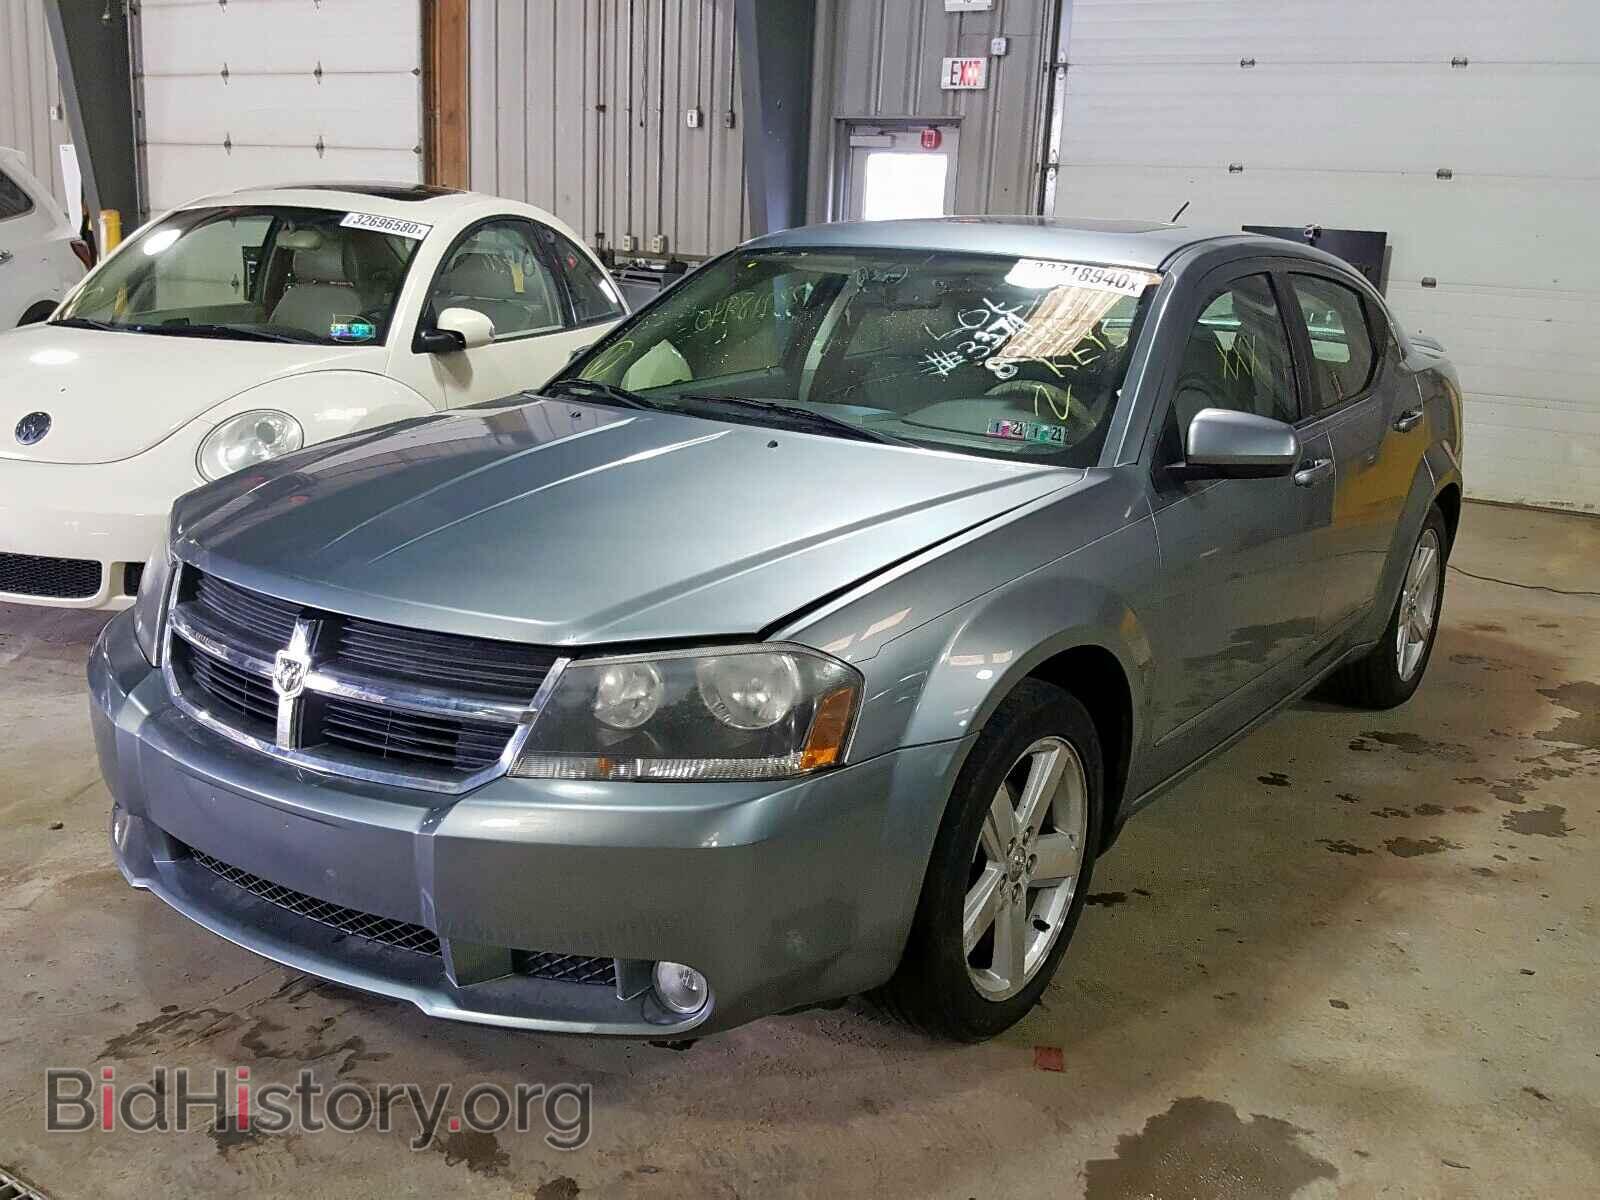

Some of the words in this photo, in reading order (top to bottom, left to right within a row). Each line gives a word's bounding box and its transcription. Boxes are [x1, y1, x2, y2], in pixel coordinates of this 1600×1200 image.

[950, 61, 981, 86] EXIT
[1012, 421, 1023, 435] 21
[1051, 426, 1062, 441] 21
